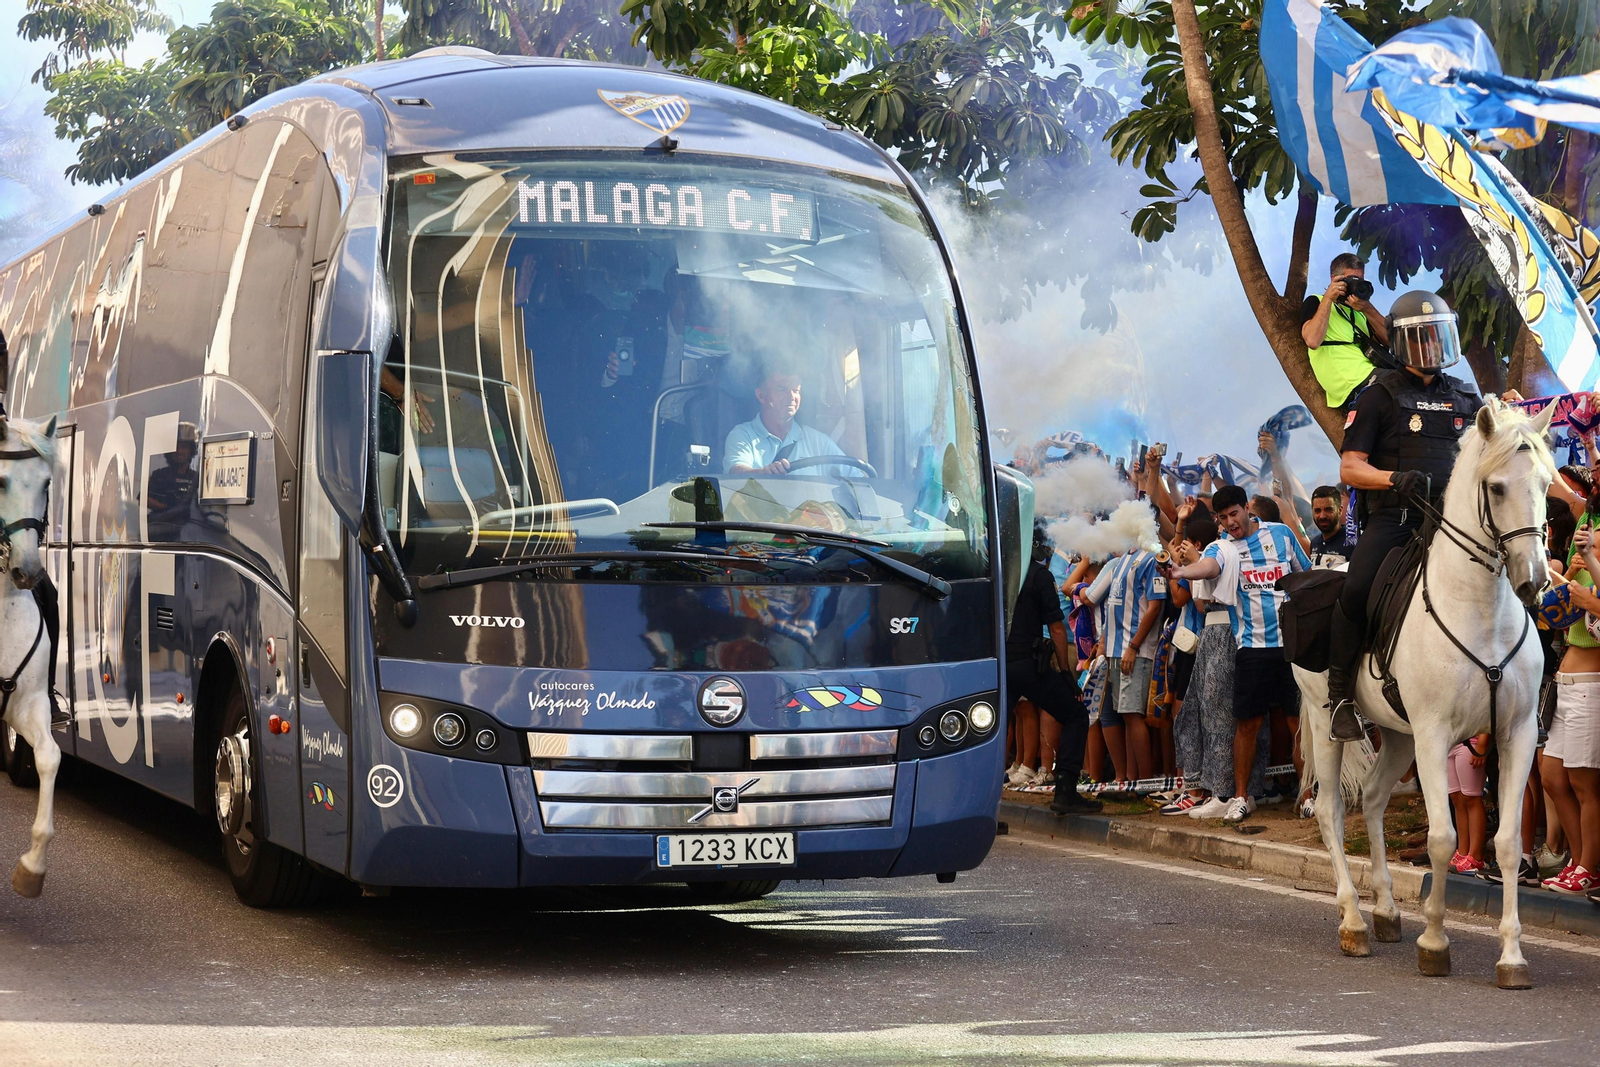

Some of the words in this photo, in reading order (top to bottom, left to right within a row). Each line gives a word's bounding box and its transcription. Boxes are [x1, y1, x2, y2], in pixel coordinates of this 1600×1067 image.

[518, 180, 704, 227] MALAGA
[727, 188, 811, 236] C.F.
[1243, 566, 1283, 583] Tivoli
[448, 614, 526, 629] VOLVO
[889, 616, 920, 634] SC7
[540, 681, 595, 691] autocares
[528, 691, 592, 716] Vázquez
[596, 691, 657, 711] Olmedo
[371, 775, 398, 797] 92
[662, 853, 667, 861] E
[678, 838, 736, 862] 1233
[745, 837, 788, 861] KCX
